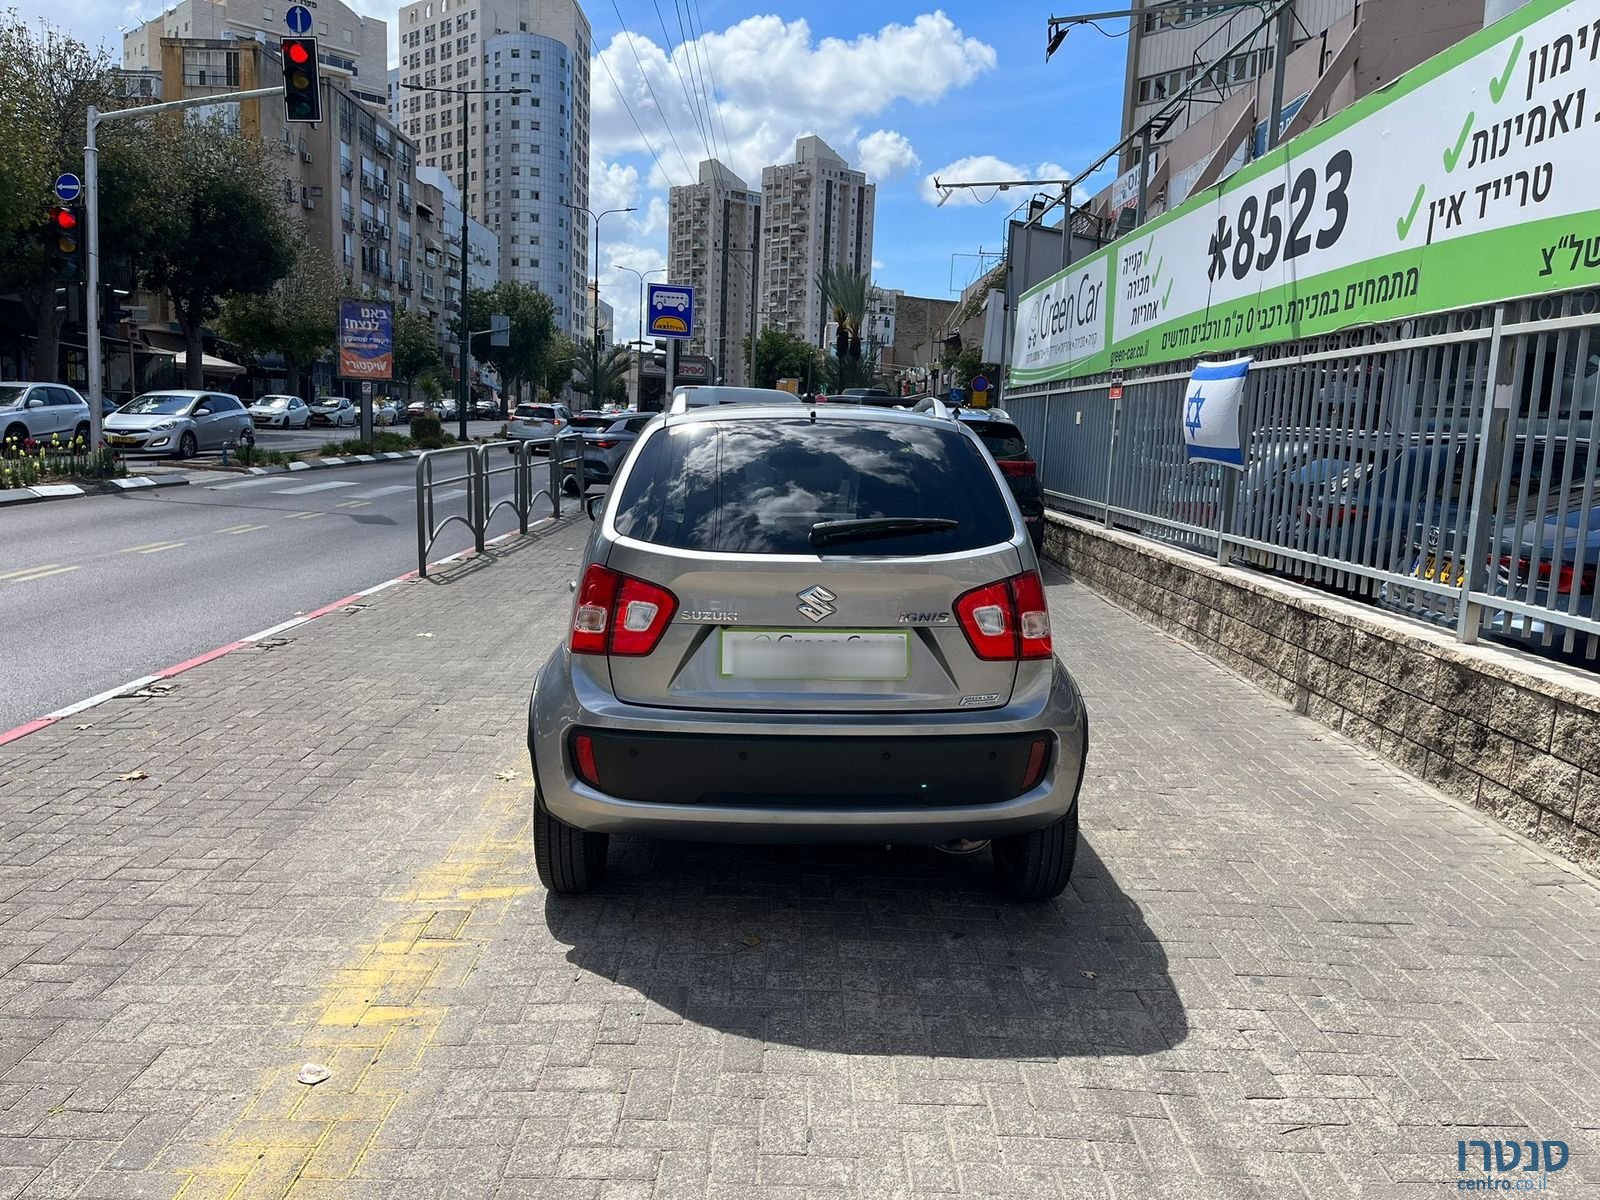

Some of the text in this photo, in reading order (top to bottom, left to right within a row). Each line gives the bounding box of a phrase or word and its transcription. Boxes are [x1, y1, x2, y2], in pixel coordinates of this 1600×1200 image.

[1468, 88, 1586, 169] ואמינות
[1426, 161, 1553, 245] טרייד אין
[1122, 250, 1143, 277] קנייה
[1127, 274, 1150, 301] מכירה
[1344, 267, 1419, 311] מתמחים
[361, 308, 388, 320] באנו
[1040, 273, 1103, 340] Green Car
[1131, 300, 1160, 326] אחריות
[1246, 307, 1253, 333] 0
[1257, 302, 1283, 331] רכבי
[1285, 290, 1339, 324] במכירת
[345, 318, 380, 331] לנצח!
[1161, 326, 1189, 350] חדשים
[1110, 339, 1149, 367] green-car.co.il
[680, 610, 738, 621] SUZUKI
